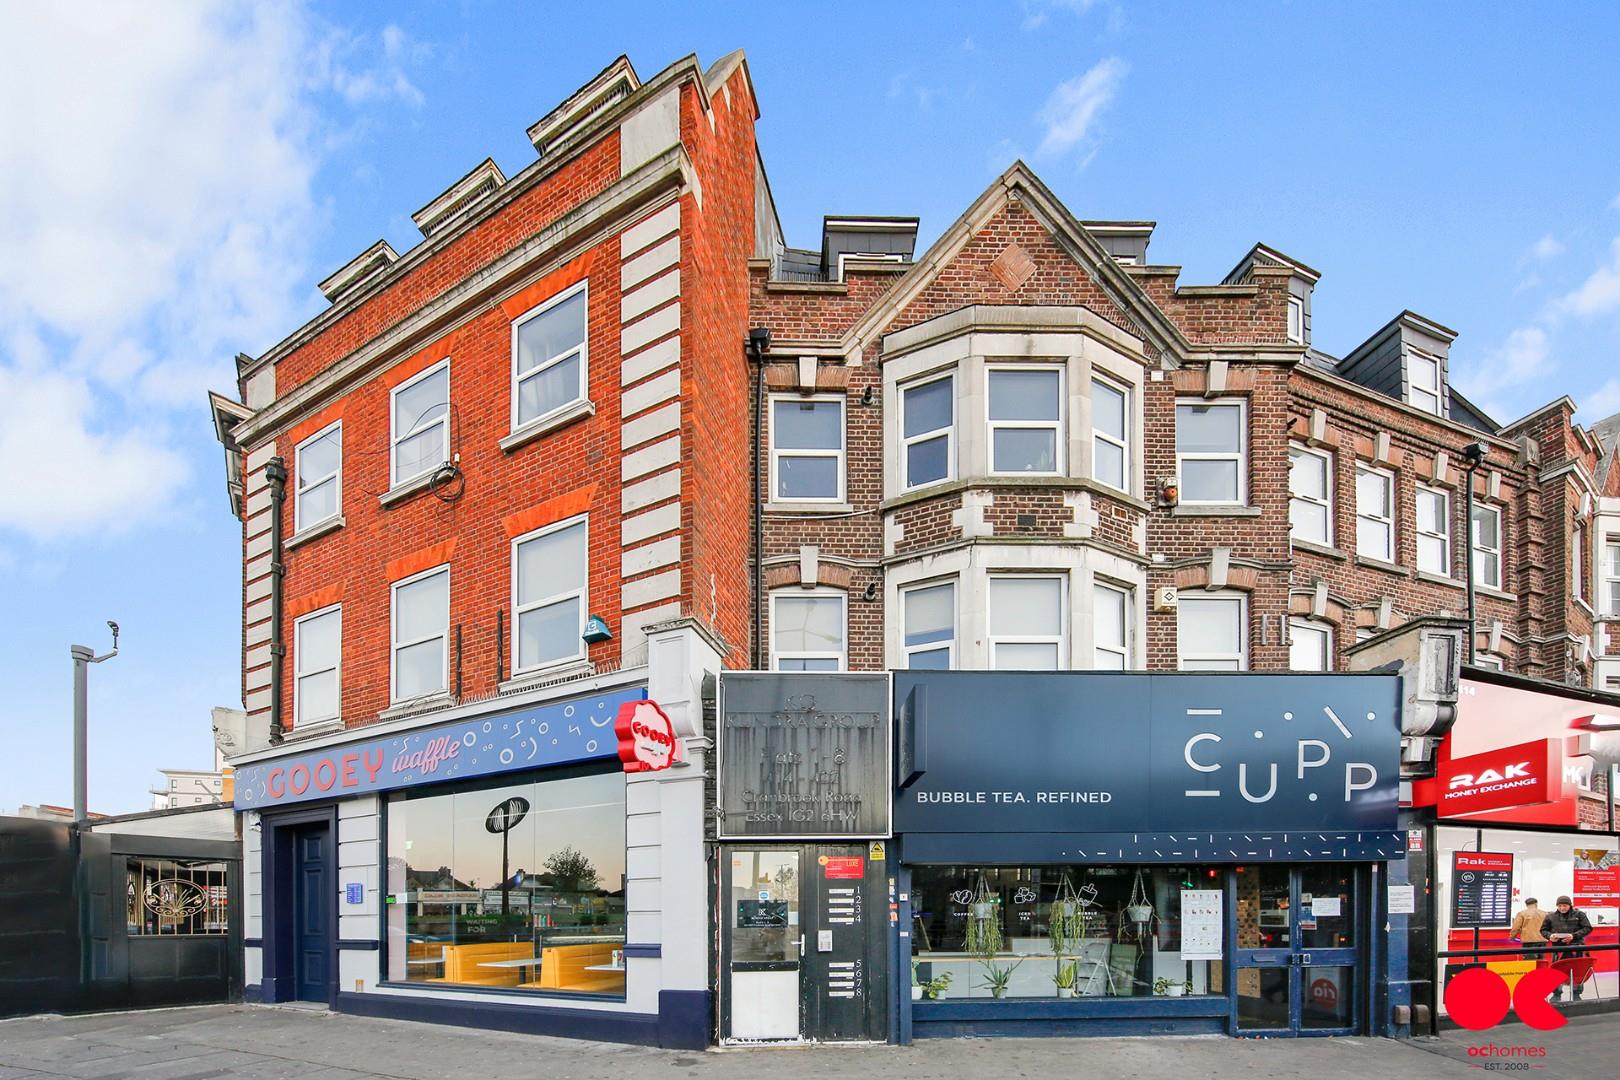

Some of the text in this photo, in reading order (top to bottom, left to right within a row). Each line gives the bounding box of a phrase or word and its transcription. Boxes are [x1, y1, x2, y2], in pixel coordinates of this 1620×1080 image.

[633, 721, 672, 747] GOOEY
[267, 735, 461, 798] GOOEY waffle
[1184, 733, 1378, 803] CUPP
[1449, 761, 1531, 790] RAK
[1445, 778, 1537, 800] MONEY EXCHANGE
[917, 792, 1112, 803] BUBBLE TEA. REFINED
[1457, 857, 1486, 865] Rak
[856, 896, 862, 904] 2
[856, 905, 861, 913] 3
[855, 914, 862, 923] 4
[856, 959, 862, 968] 5
[856, 969, 862, 977] 6
[856, 978, 862, 987] 7
[856, 988, 862, 997] 8
